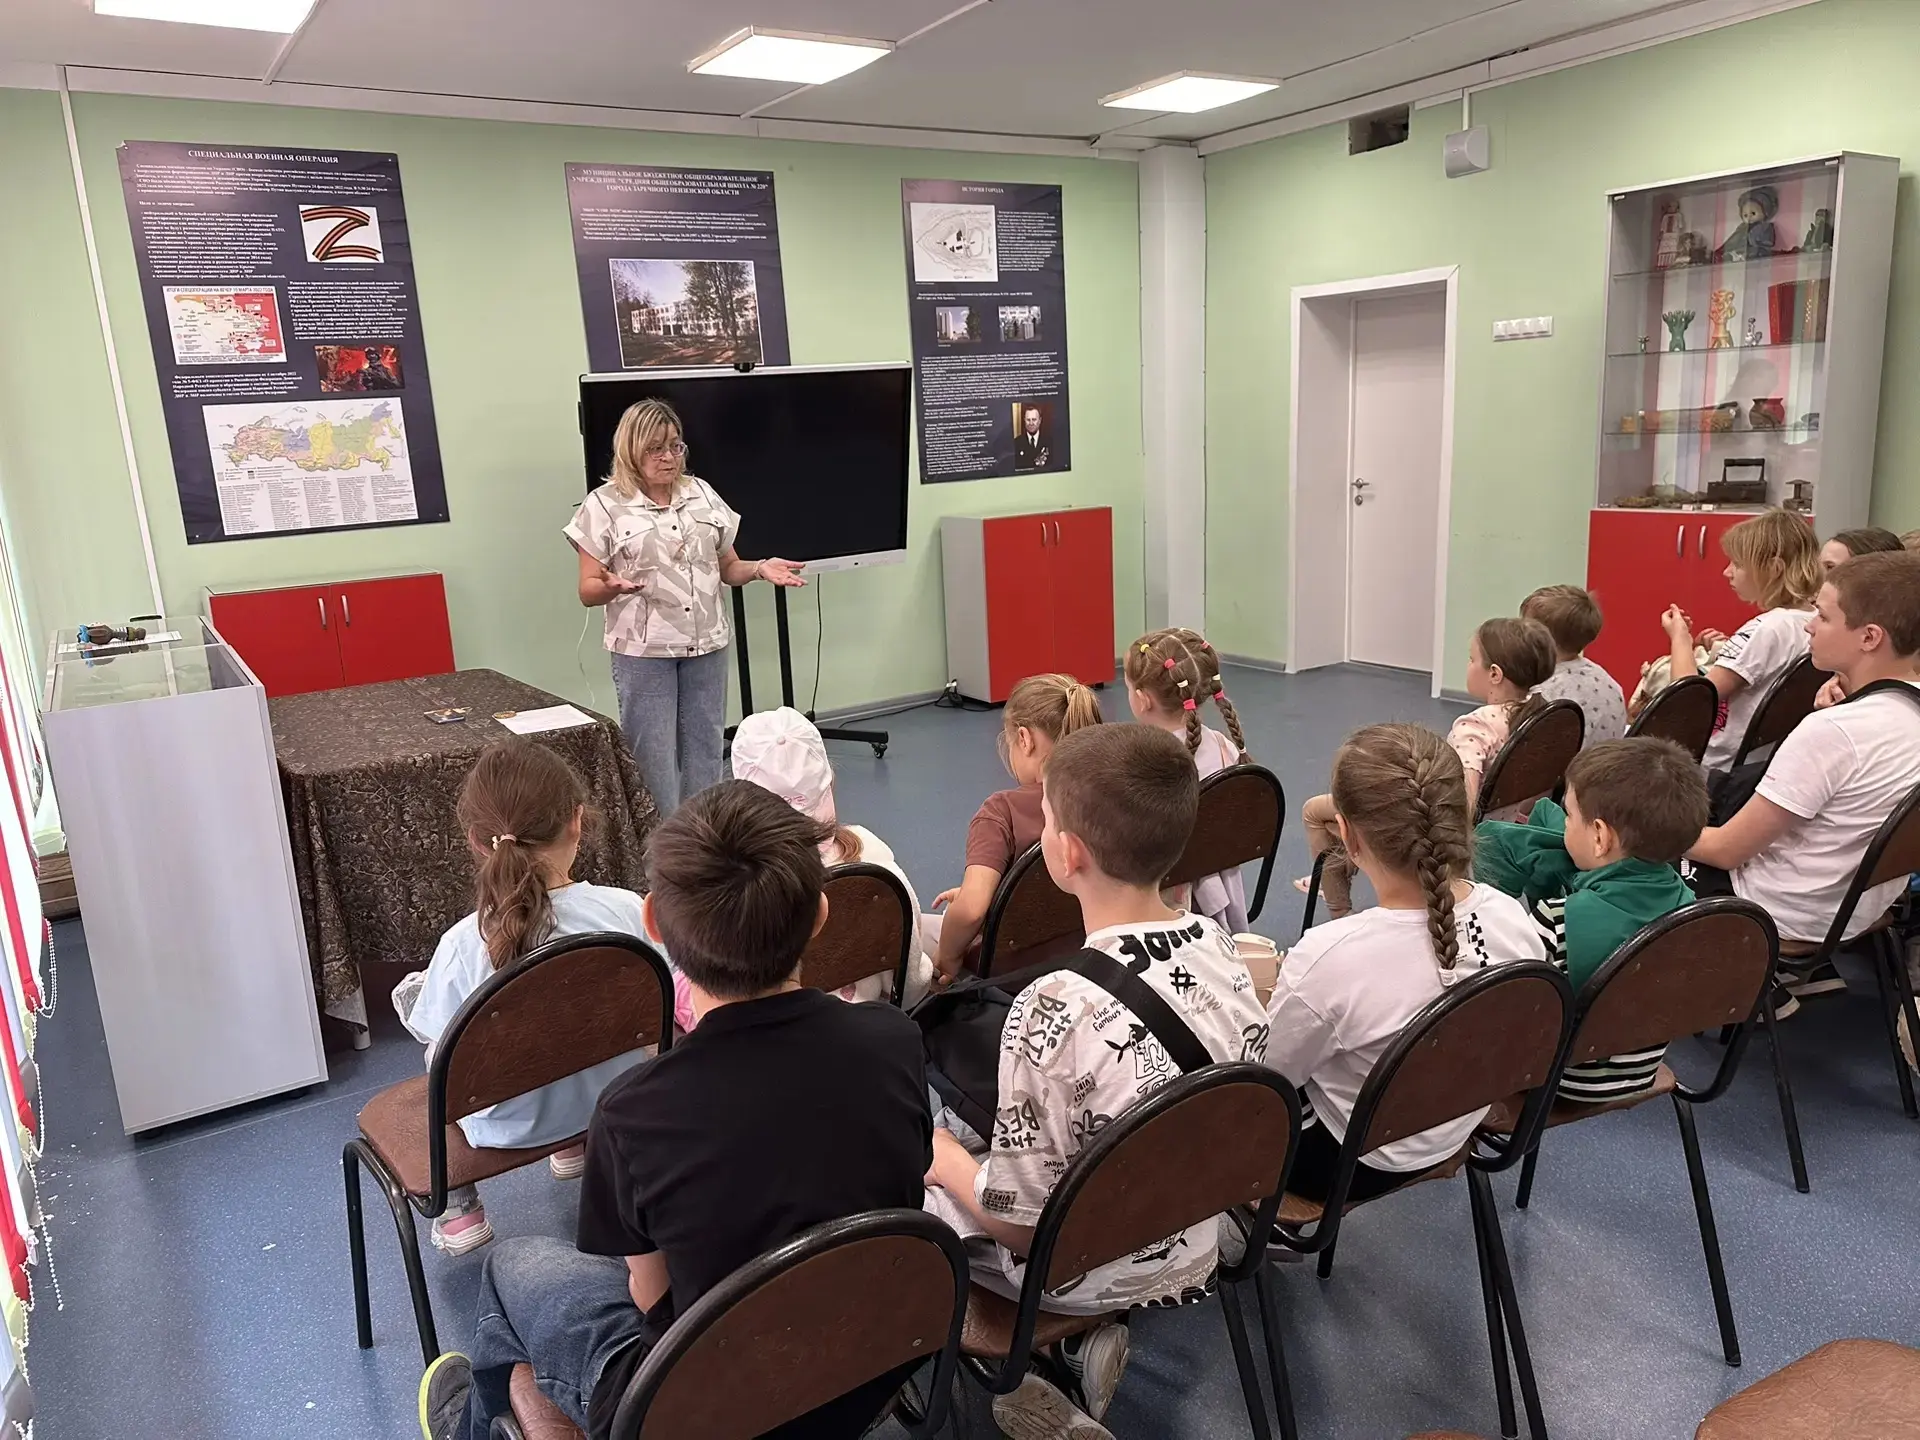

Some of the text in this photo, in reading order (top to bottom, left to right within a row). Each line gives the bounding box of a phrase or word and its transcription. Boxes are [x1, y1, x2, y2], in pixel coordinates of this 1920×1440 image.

[188, 150, 339, 164] СПЕЦИАЛЬНАЯ ВОЕННАЯ ОПЕРАЦИЯ
[582, 169, 758, 182] МУНИЦИПАЛЬНОЕ БЮДЖЕТНОЕ ОБЩЕОБРАЗОВАТЕЛЬНОЕ
[572, 176, 617, 184] УЧРЕЖДЕНИЕ
[651, 179, 726, 188] ОБЩЕОБРАЗОВАТЕЛЬНАЯ
[727, 182, 749, 190] ШКОЛА
[606, 184, 740, 196] ГОРОДА ЗАРЕЧНОГО ПЕНЗЕНСКОЙ ОБЛАСТИ
[1092, 1006, 1110, 1020] the
[1092, 1010, 1121, 1032] famous
[1047, 1012, 1072, 1049] the
[992, 1098, 1040, 1137] BES
[998, 1132, 1036, 1149] the
[1043, 1160, 1065, 1168] wave
[1052, 1168, 1066, 1177] ost
[988, 1192, 1010, 1202] VIBES
[1191, 1272, 1206, 1284] DAY
[1168, 1280, 1190, 1293] EVER
